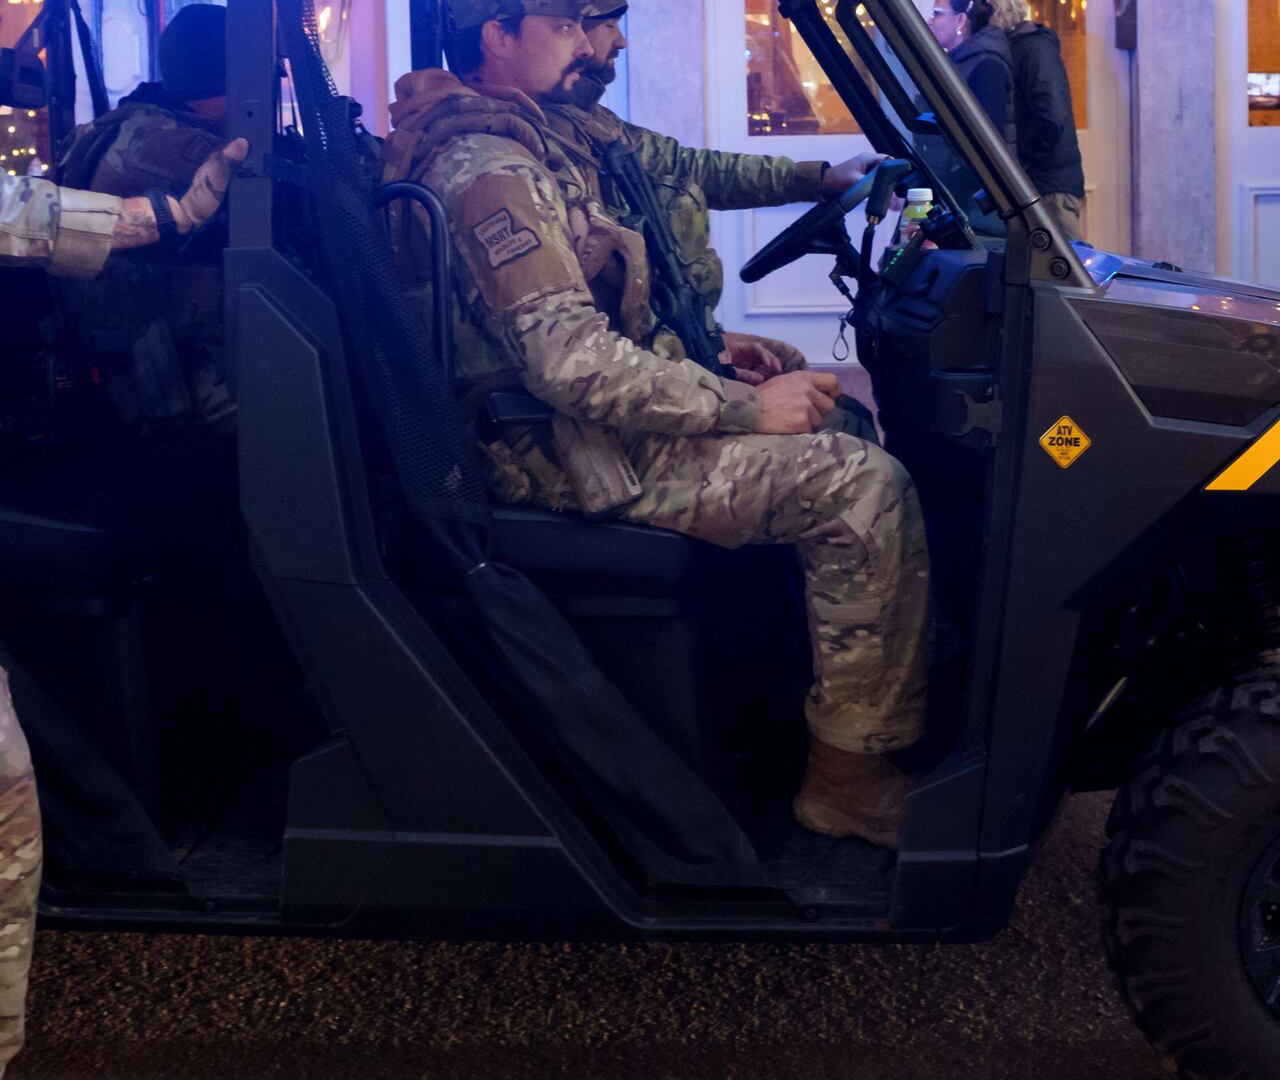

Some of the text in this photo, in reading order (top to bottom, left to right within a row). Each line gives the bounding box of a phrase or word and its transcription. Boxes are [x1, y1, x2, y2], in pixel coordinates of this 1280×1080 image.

[484, 226, 511, 249] MSRT
[1056, 425, 1073, 436] ATV
[1047, 436, 1081, 447] ZONE
